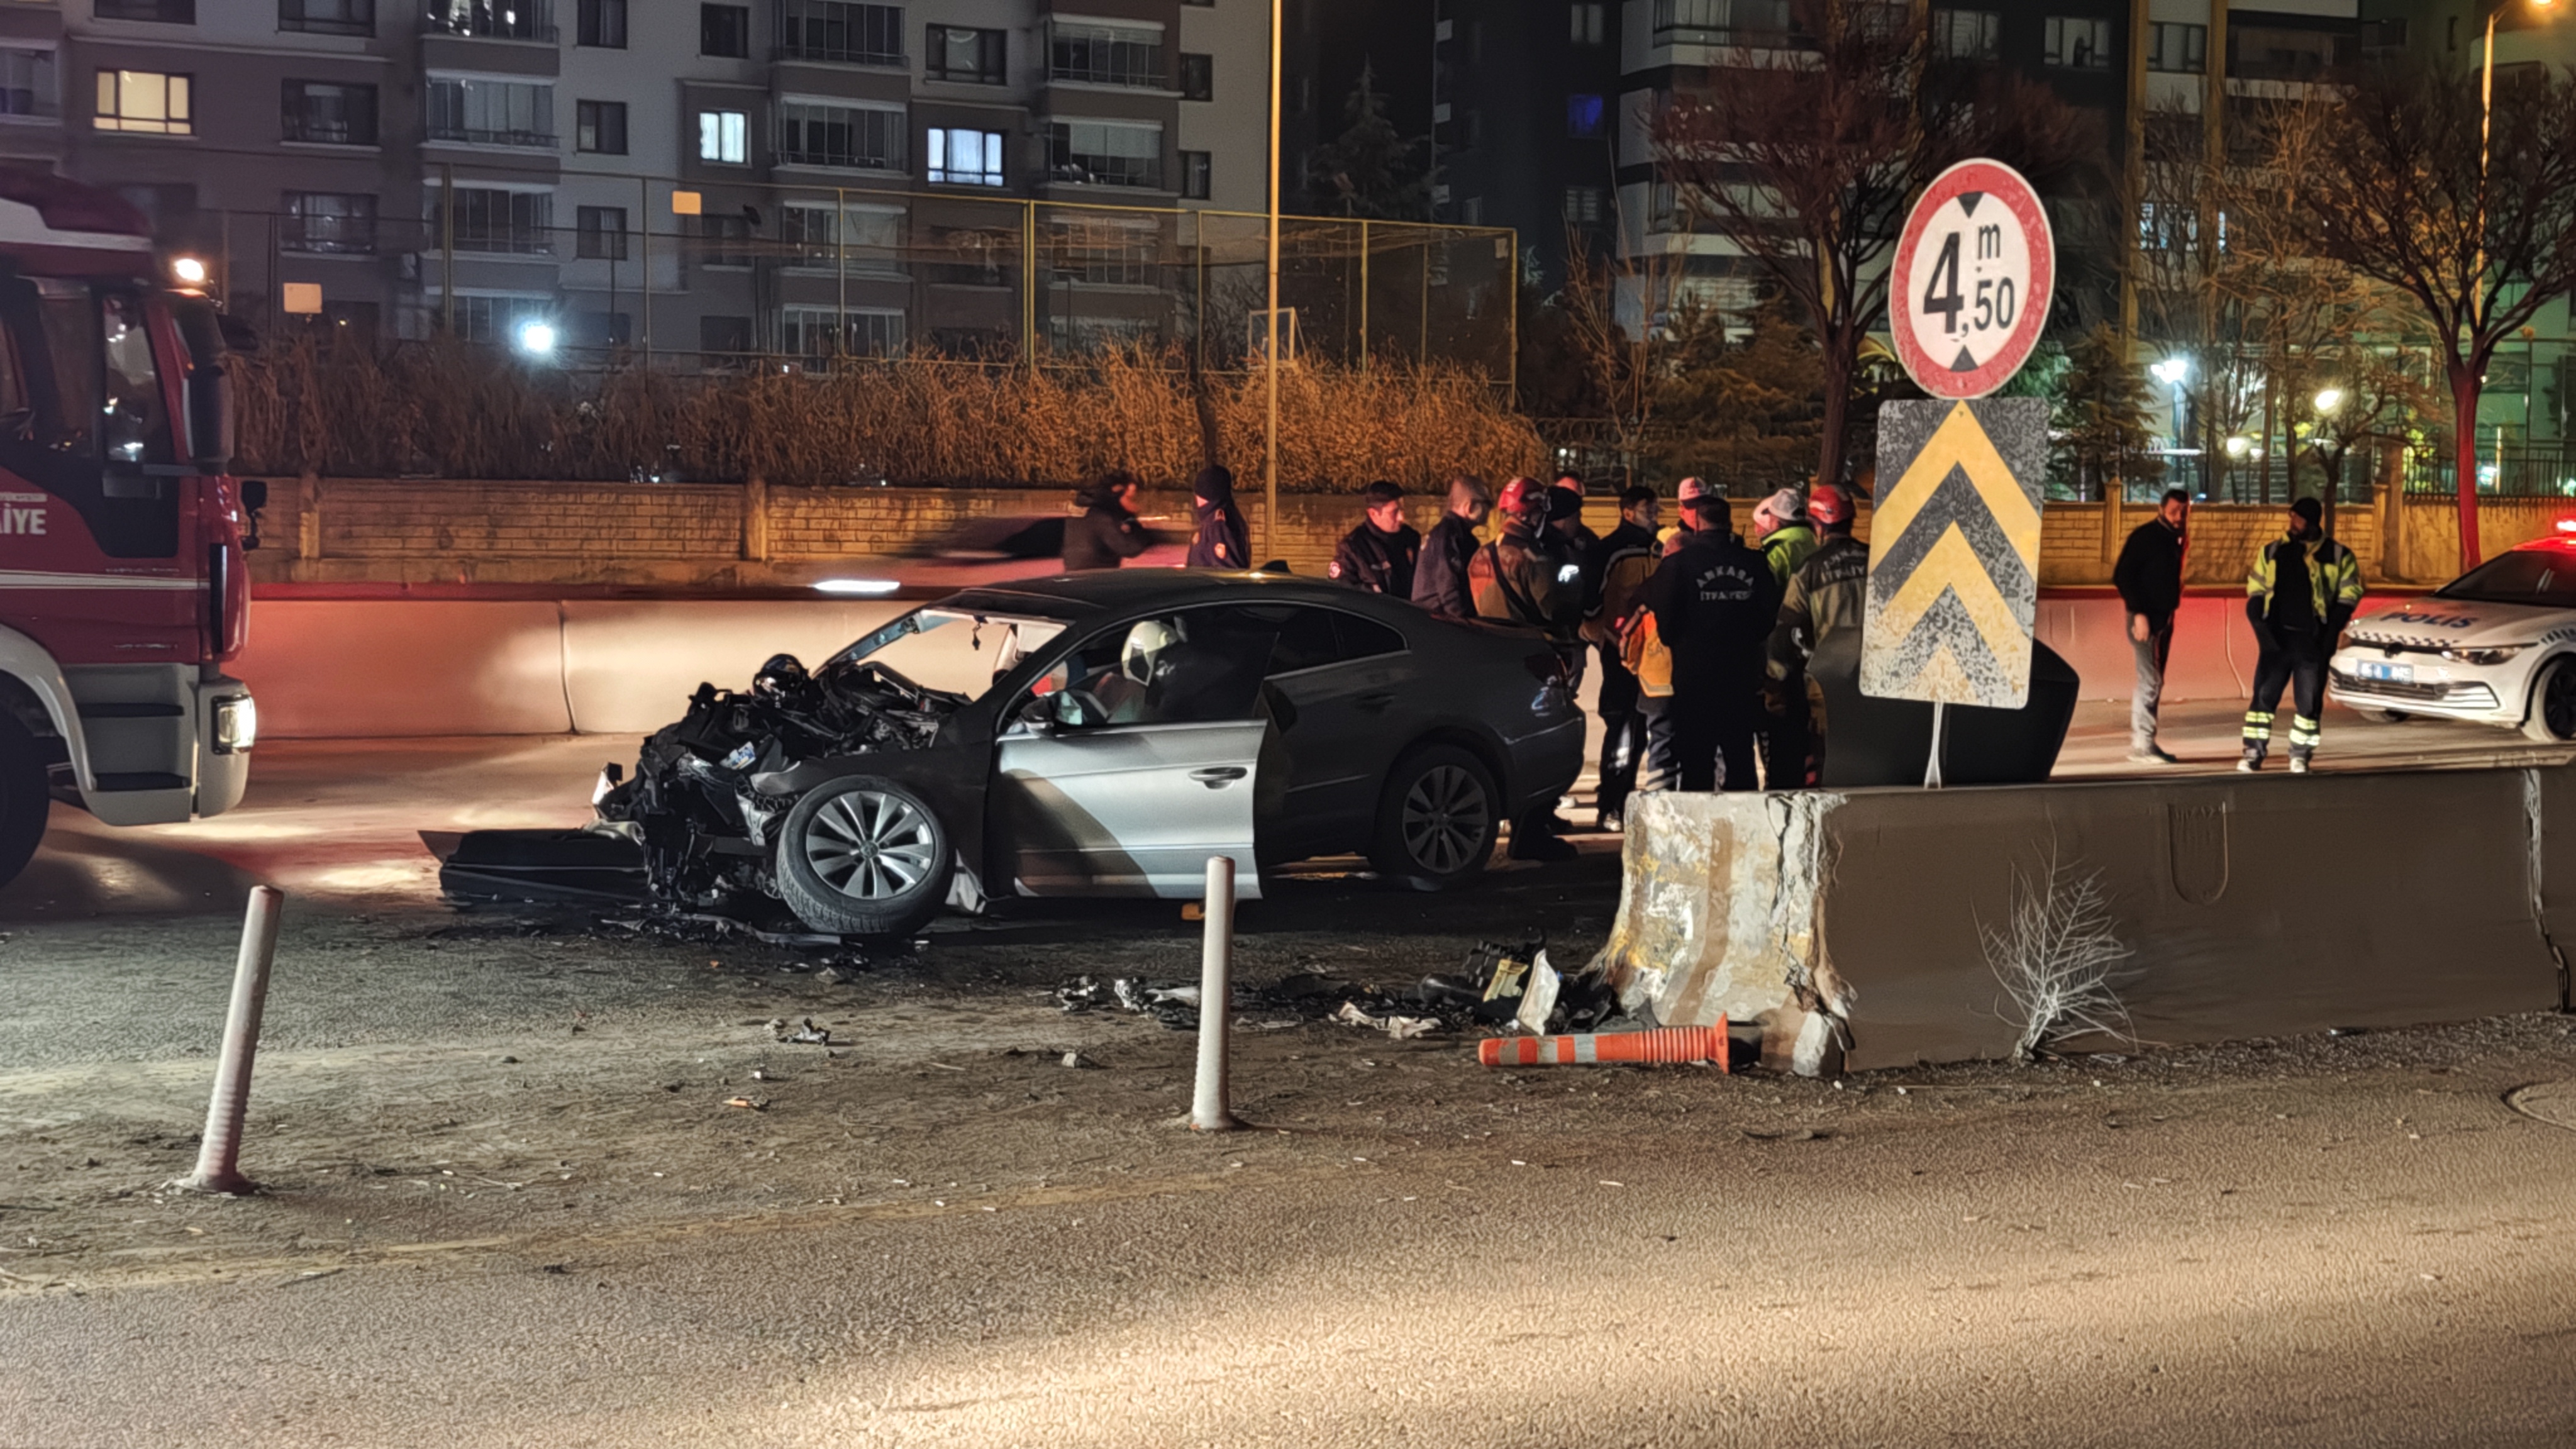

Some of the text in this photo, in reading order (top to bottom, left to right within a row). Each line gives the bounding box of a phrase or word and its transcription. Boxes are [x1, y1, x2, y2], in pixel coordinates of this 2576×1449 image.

[1977, 223, 2001, 261] m
[0, 502, 47, 535] İYE
[1696, 565, 1754, 589] ANKARA
